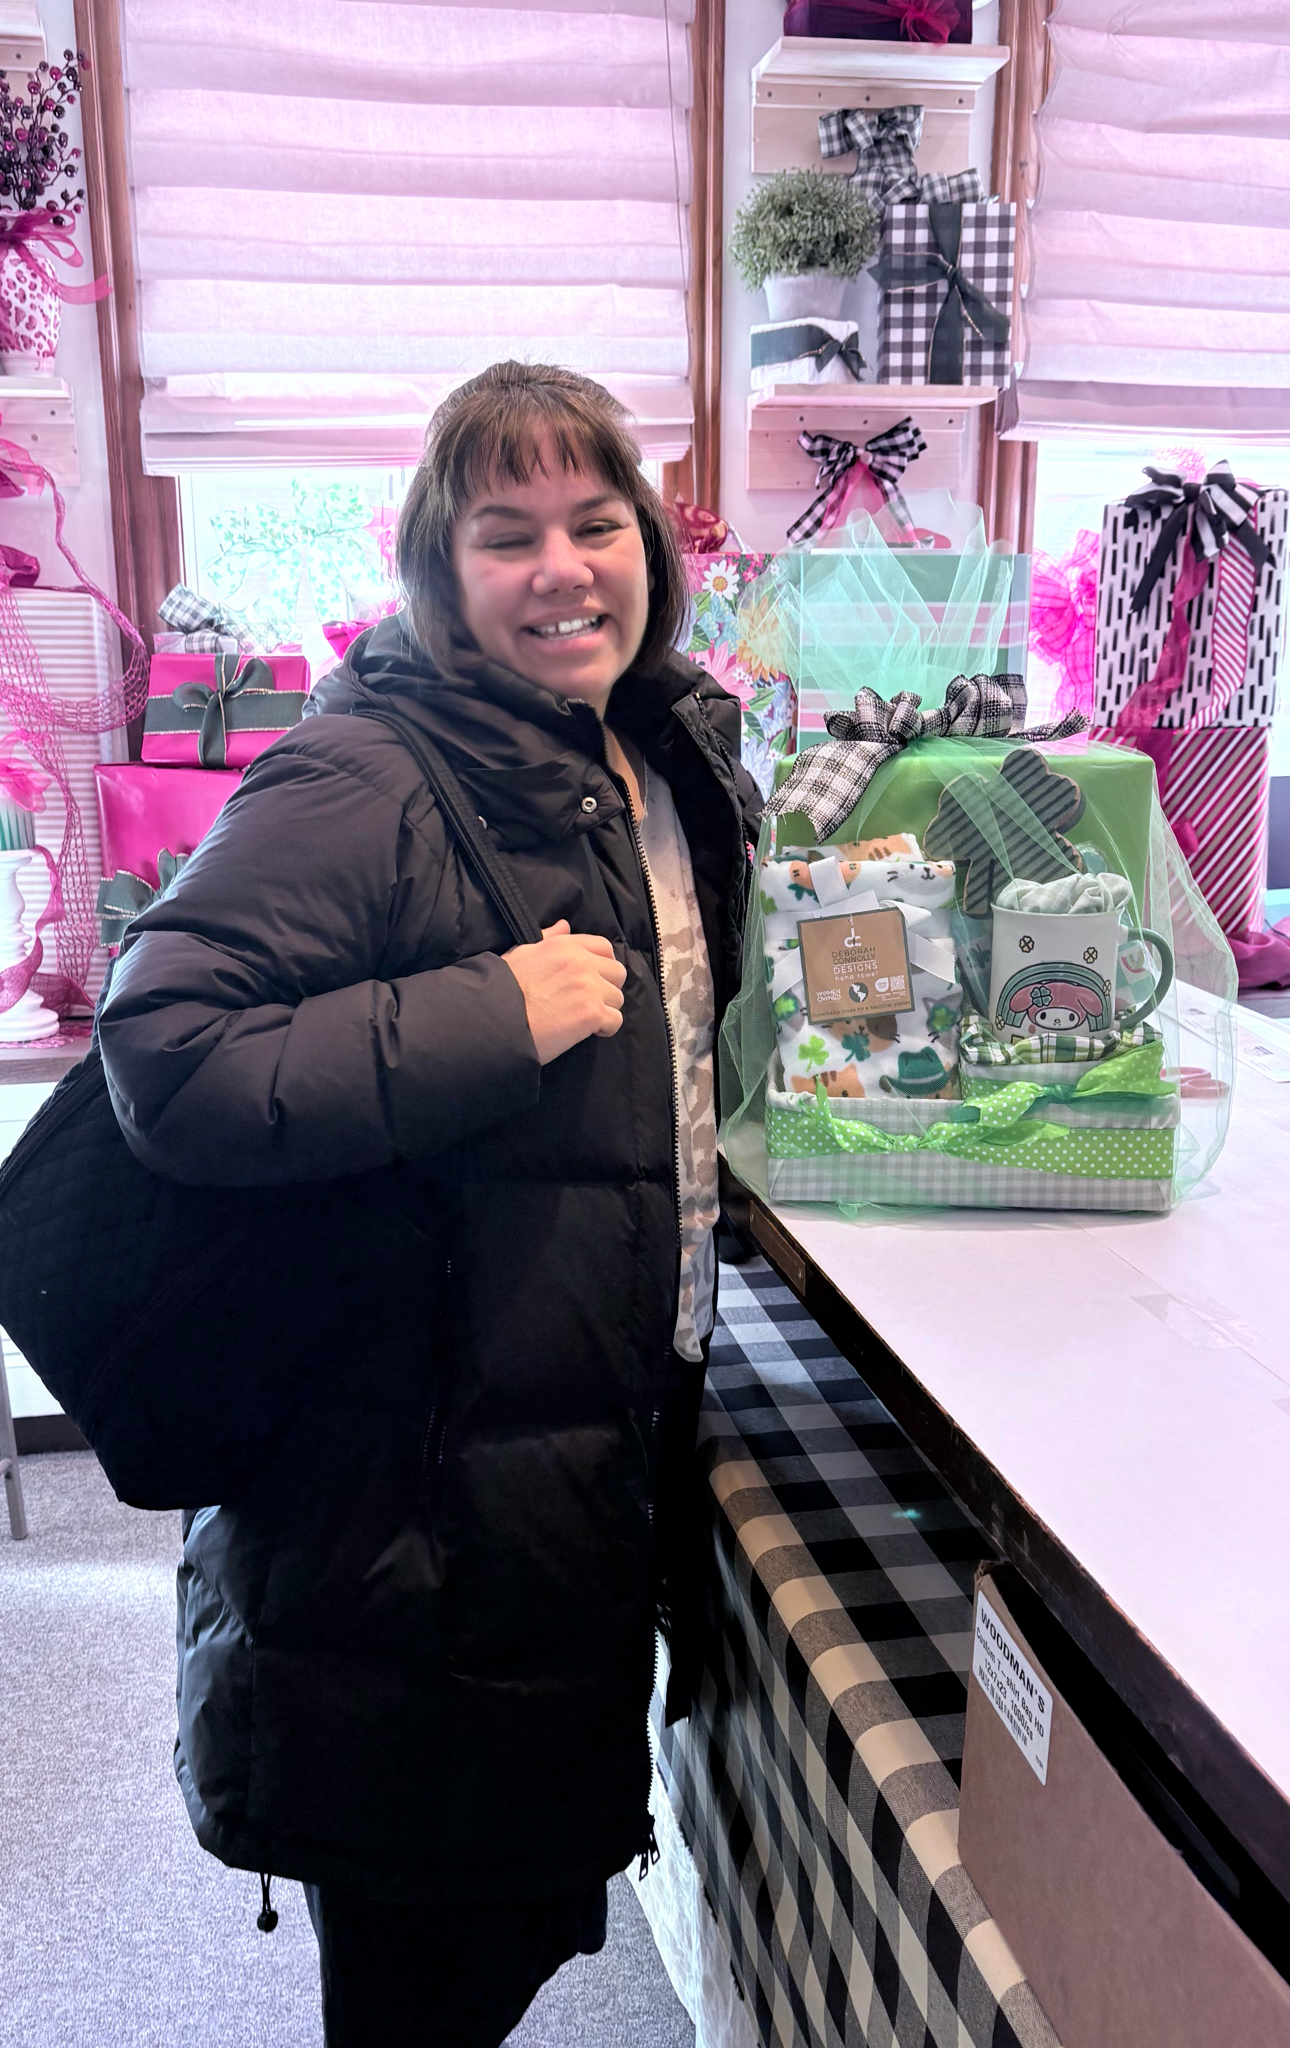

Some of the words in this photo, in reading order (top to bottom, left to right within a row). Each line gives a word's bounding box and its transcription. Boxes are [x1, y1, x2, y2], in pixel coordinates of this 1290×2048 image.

[832, 947, 876, 958] DEBORAH
[833, 953, 876, 965] CONNOLLY
[833, 961, 878, 974] DESIGNS
[835, 974, 854, 982] hand
[857, 970, 878, 979] towel
[817, 994, 841, 1002] OWNED
[981, 1607, 1045, 1714] WOODMAN'S
[977, 1626, 996, 1664] Custom
[1021, 1697, 1033, 1723] Bag
[1034, 1716, 1044, 1738] HD
[978, 1665, 990, 1691] MADE
[985, 1658, 1007, 1699] 12x7x23
[1011, 1699, 1033, 1741] 1000/cs
